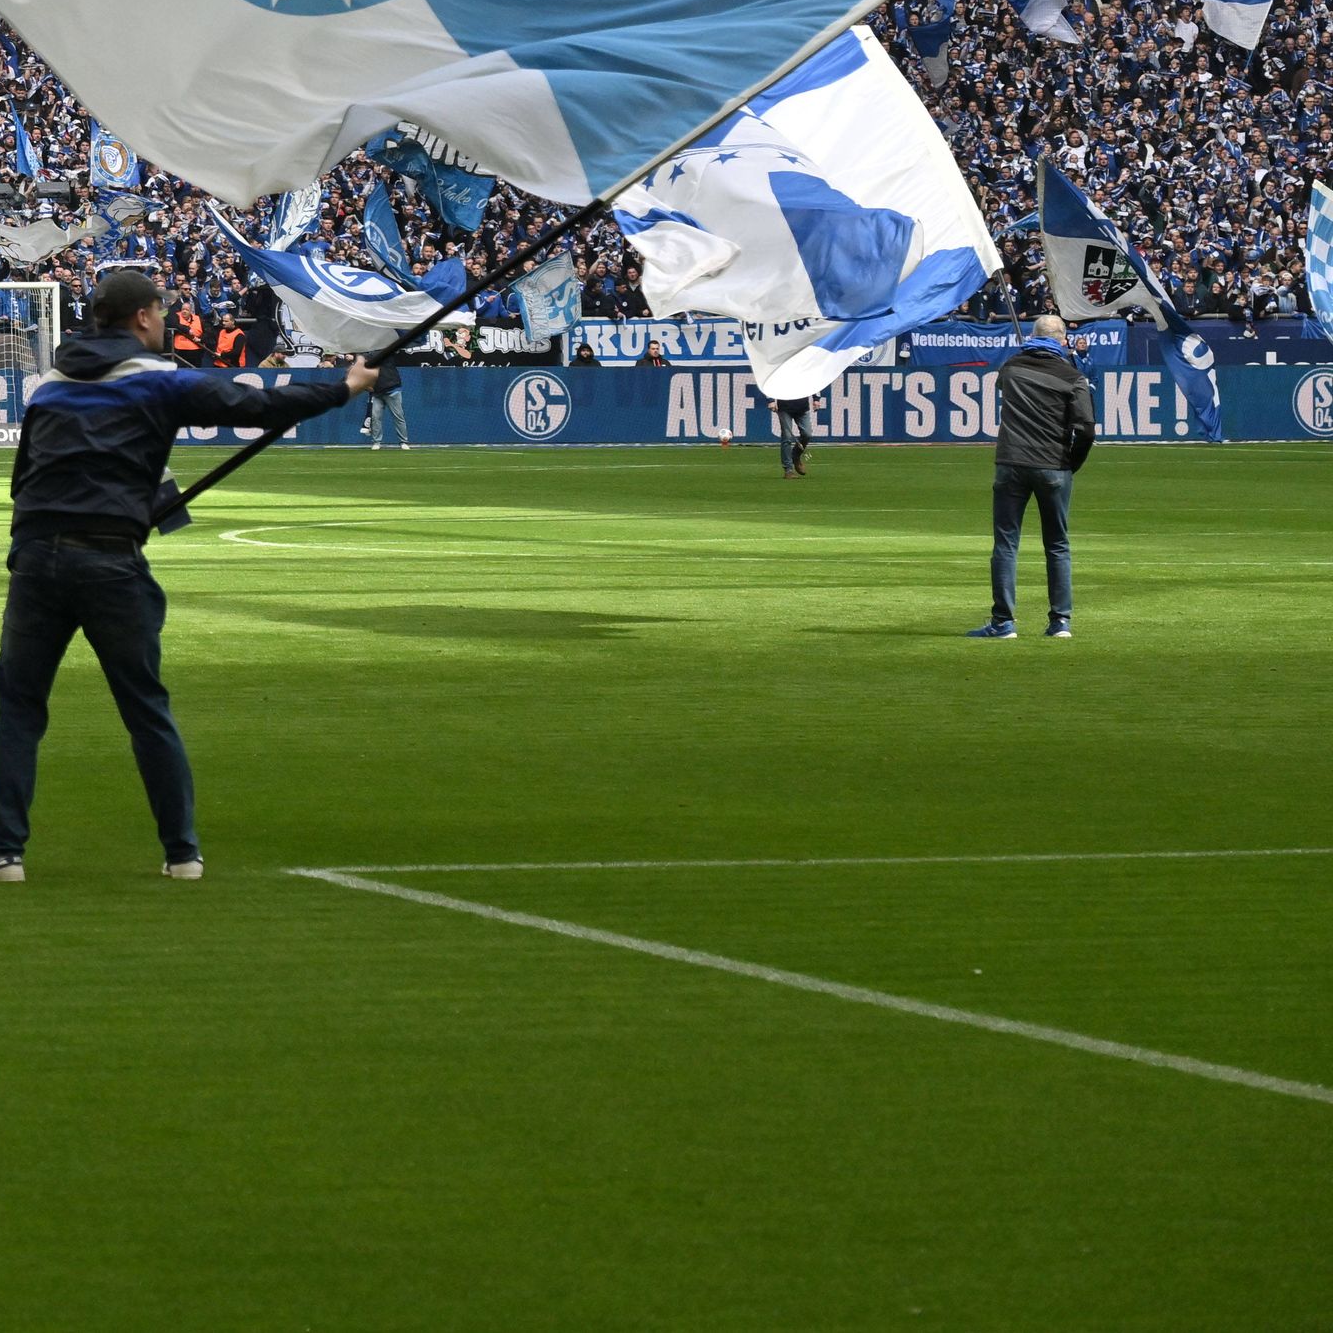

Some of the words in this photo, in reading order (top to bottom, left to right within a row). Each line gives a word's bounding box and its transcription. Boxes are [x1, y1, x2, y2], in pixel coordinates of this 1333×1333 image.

[584, 321, 744, 357] KURVE
[1099, 330, 1122, 346] e.V.
[665, 372, 757, 438] AUF
